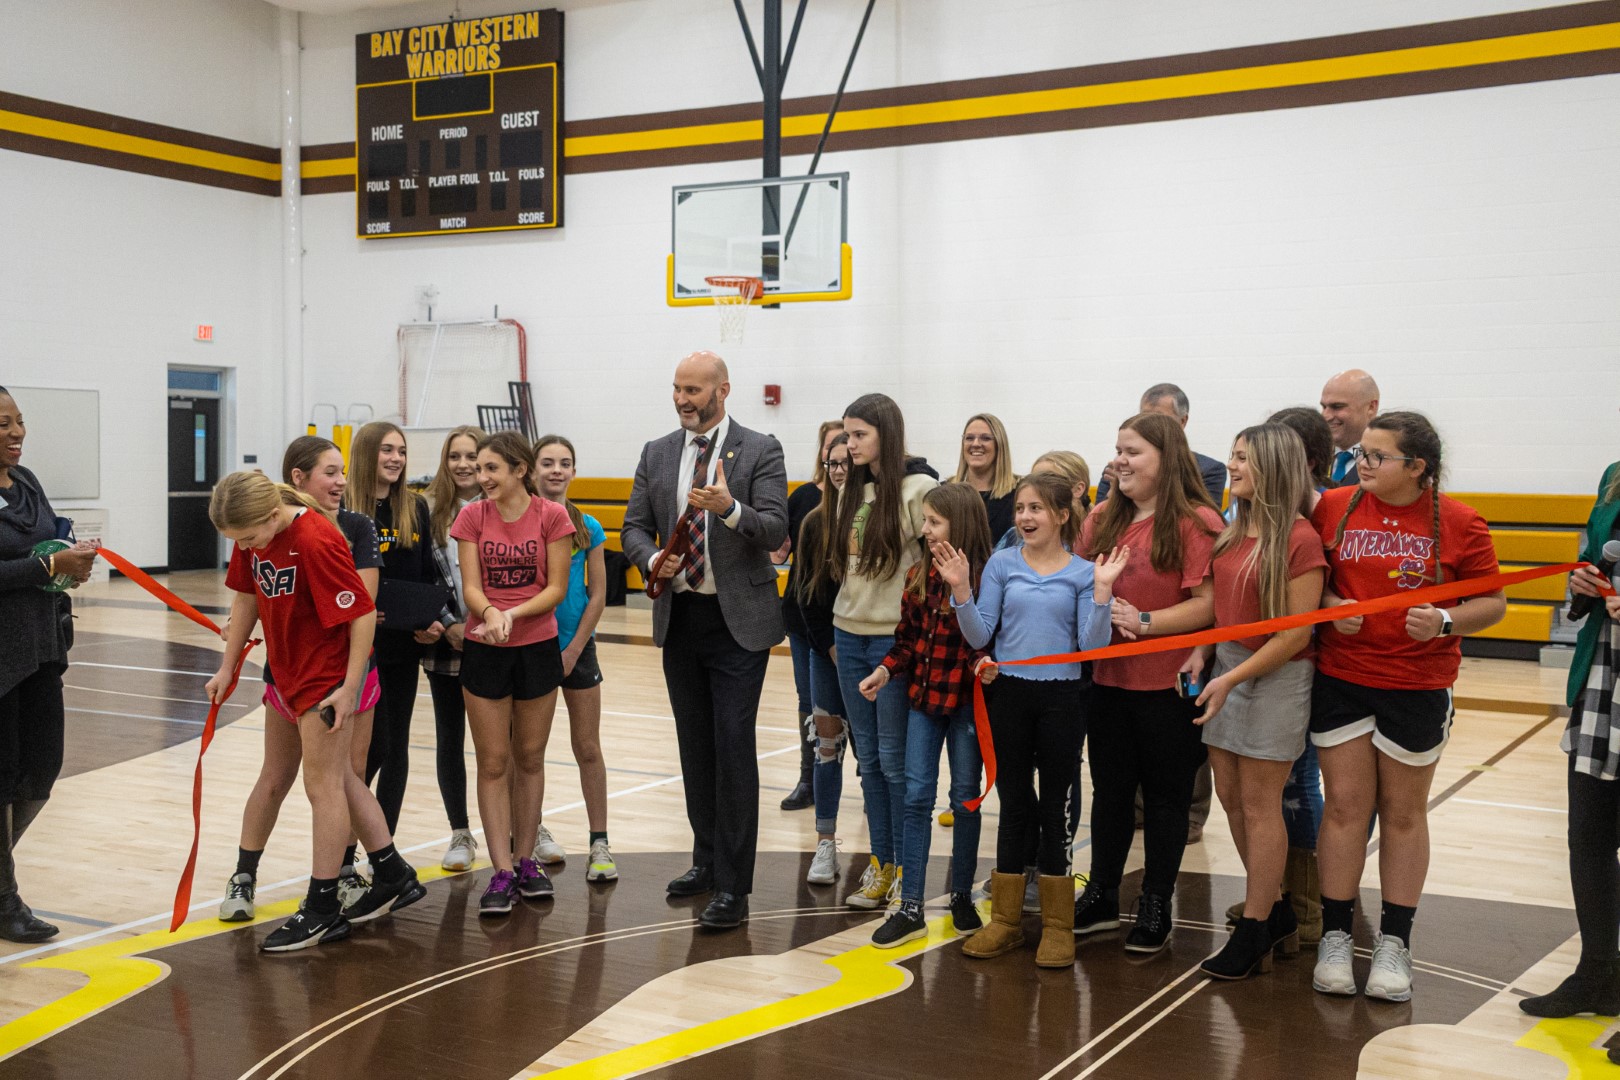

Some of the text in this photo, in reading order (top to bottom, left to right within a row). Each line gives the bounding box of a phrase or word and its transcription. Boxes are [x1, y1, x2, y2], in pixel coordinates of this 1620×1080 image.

[371, 12, 540, 58] BAY CITY WESTERN
[406, 44, 501, 78] WARRIORS
[501, 110, 540, 130] GUEST
[371, 124, 404, 142] HOME
[439, 126, 468, 140] PERIOD
[428, 173, 480, 188] PLAYER FOUL
[518, 167, 545, 181] FOULS
[366, 180, 390, 192] FOULS
[440, 217, 467, 230] MATCH
[518, 212, 545, 224] SCORE
[366, 222, 391, 234] SCORE
[482, 540, 538, 557] GOING
[482, 555, 538, 566] NOWHERE
[488, 568, 536, 586] FAST
